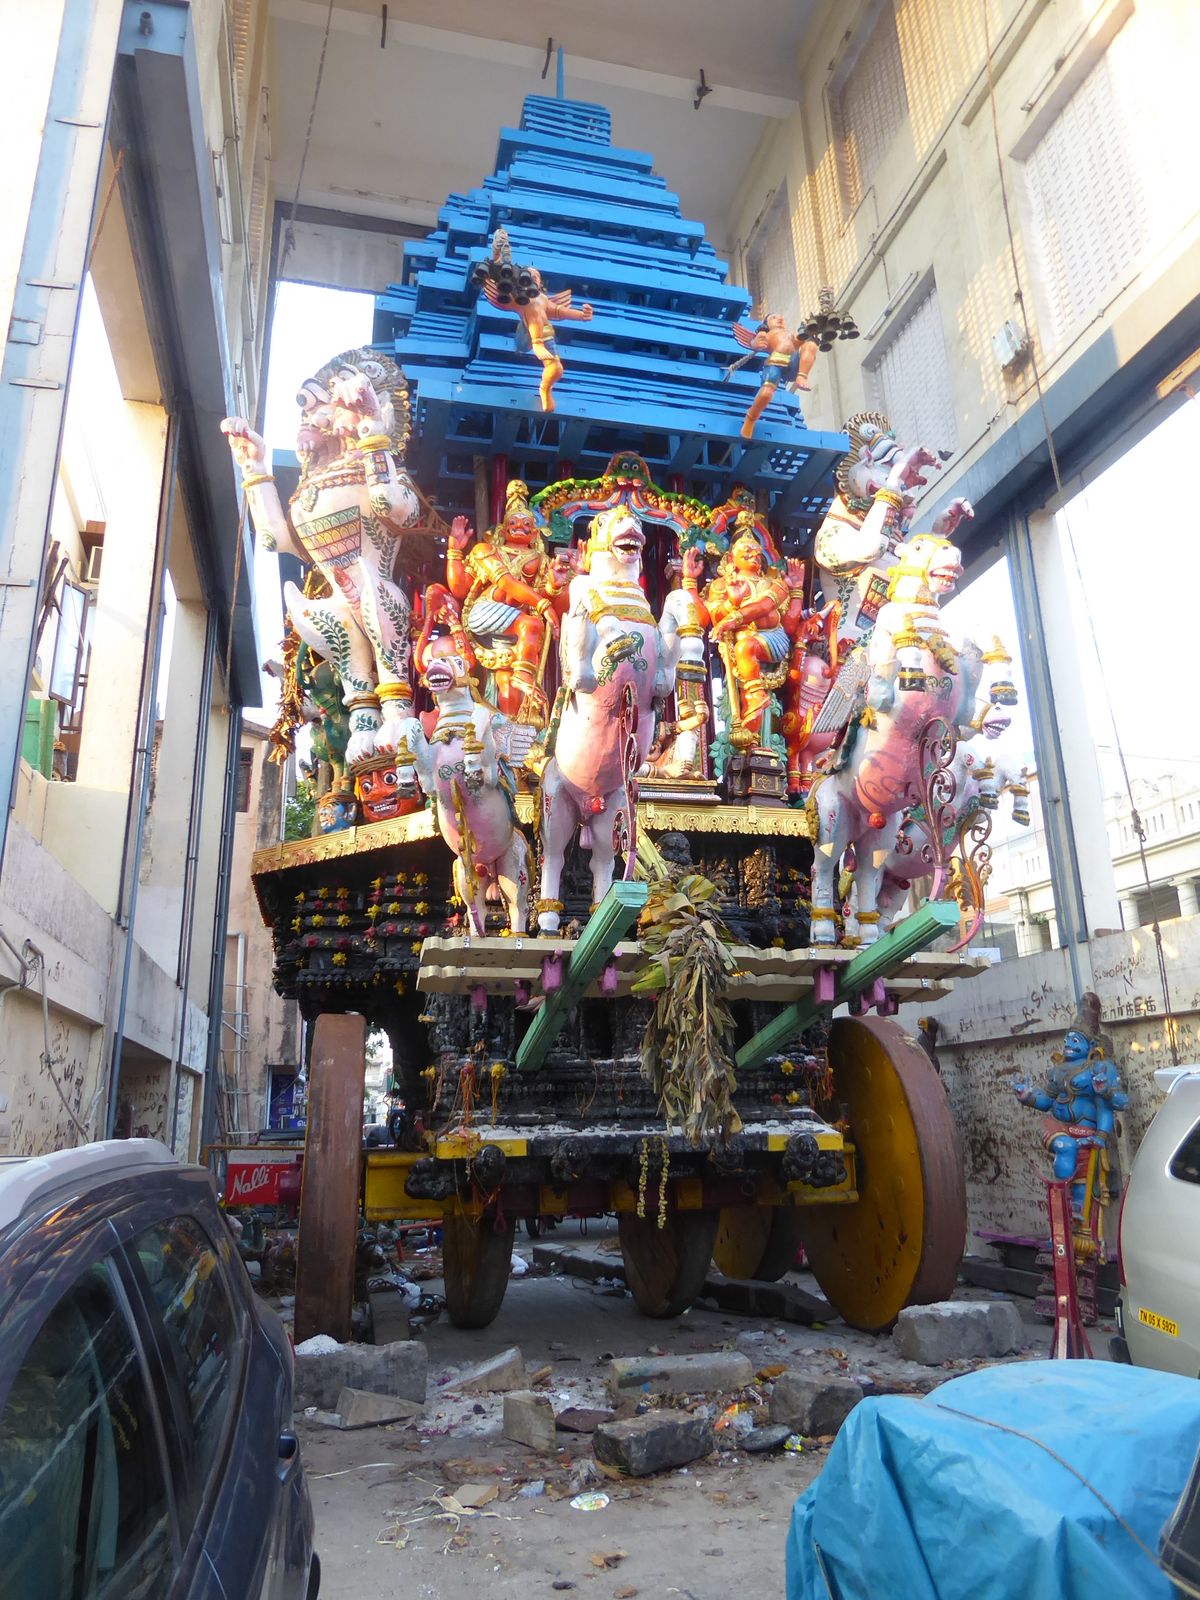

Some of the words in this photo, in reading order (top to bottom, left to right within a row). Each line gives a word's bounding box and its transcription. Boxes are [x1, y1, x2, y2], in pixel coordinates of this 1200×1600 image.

[229, 1165, 270, 1201] Nalli
[1140, 1310, 1148, 1322] TN
[1148, 1313, 1156, 1326] 05
